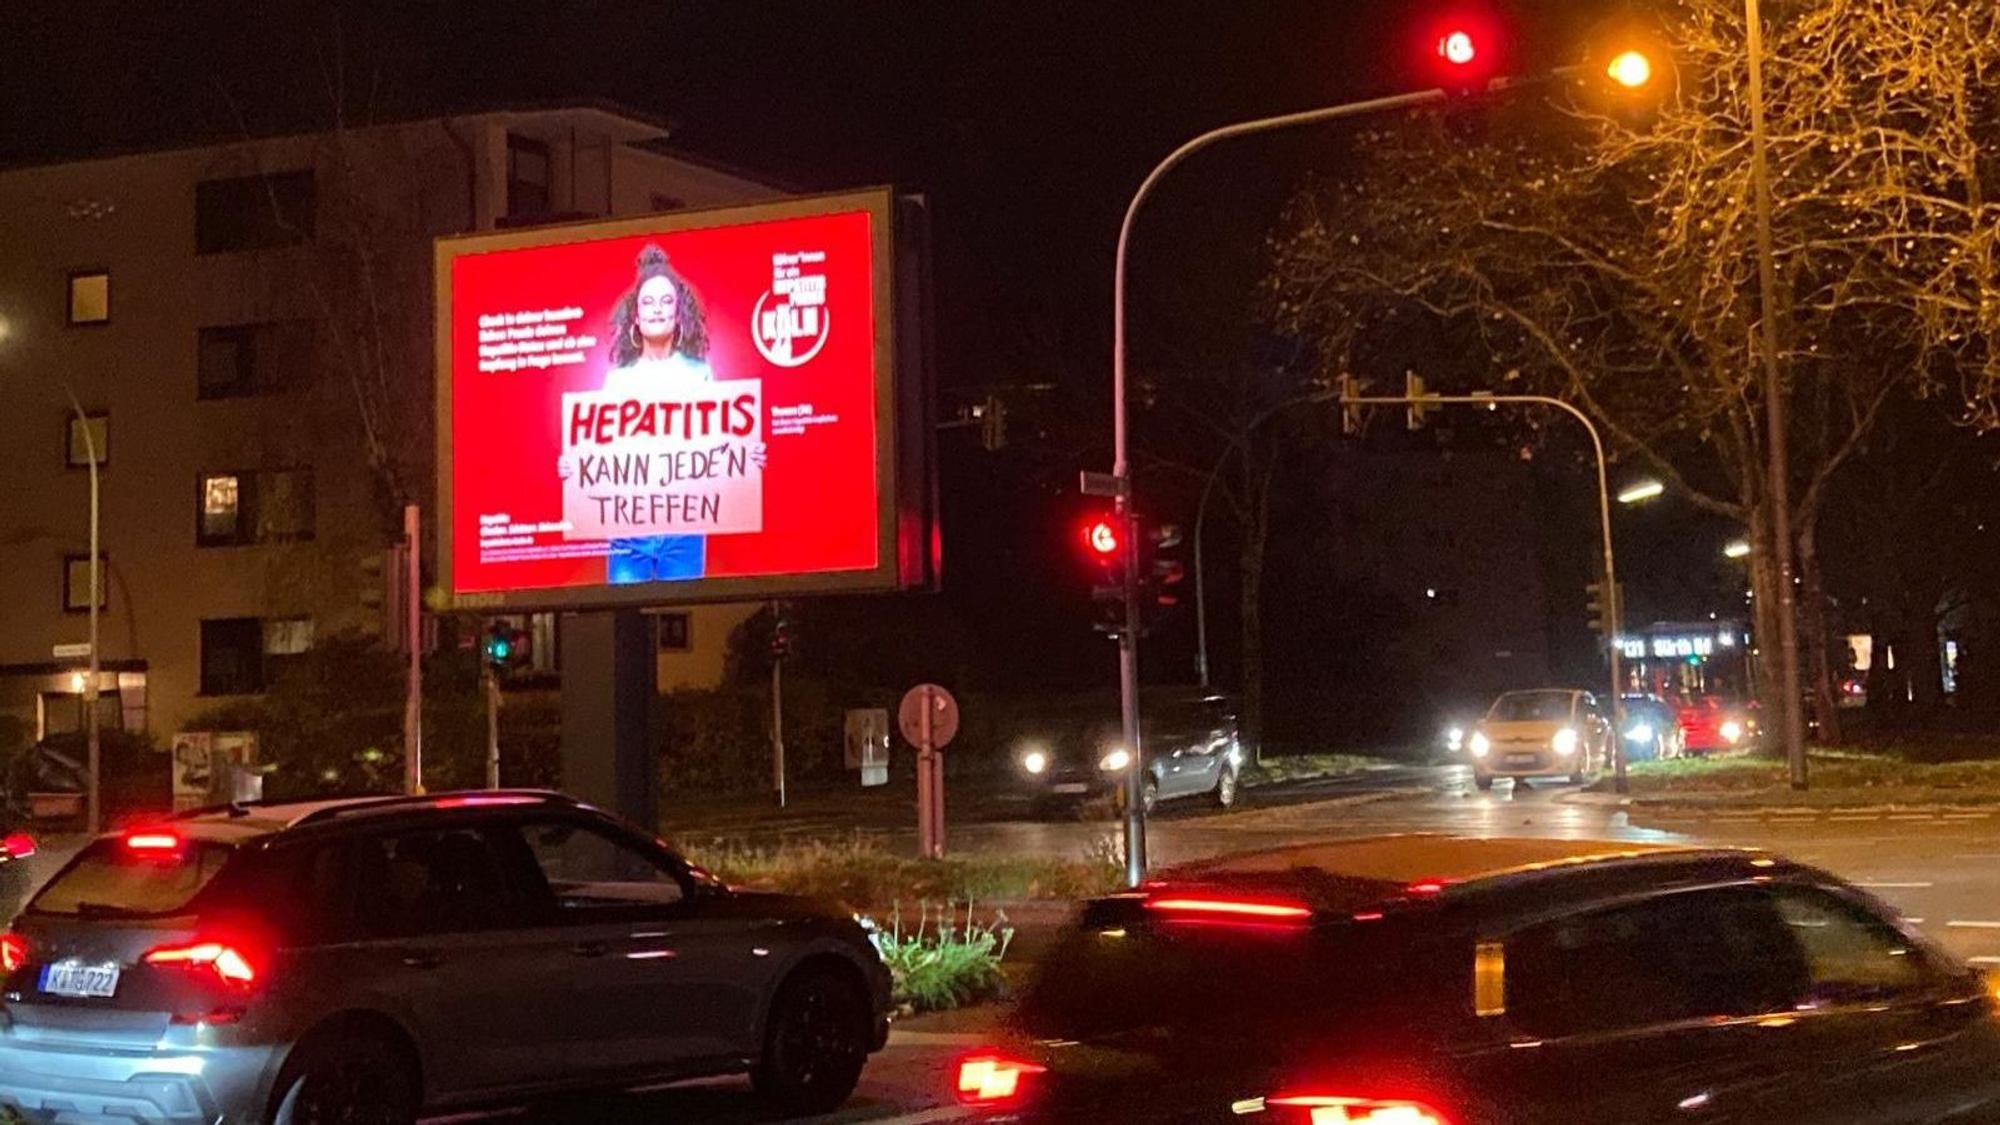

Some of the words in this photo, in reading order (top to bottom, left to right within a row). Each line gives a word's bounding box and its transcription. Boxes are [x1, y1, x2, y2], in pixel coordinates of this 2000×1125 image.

[570, 393, 756, 447] HEPATITIS
[579, 453, 650, 489] KANN
[588, 493, 720, 526] TREFFEN
